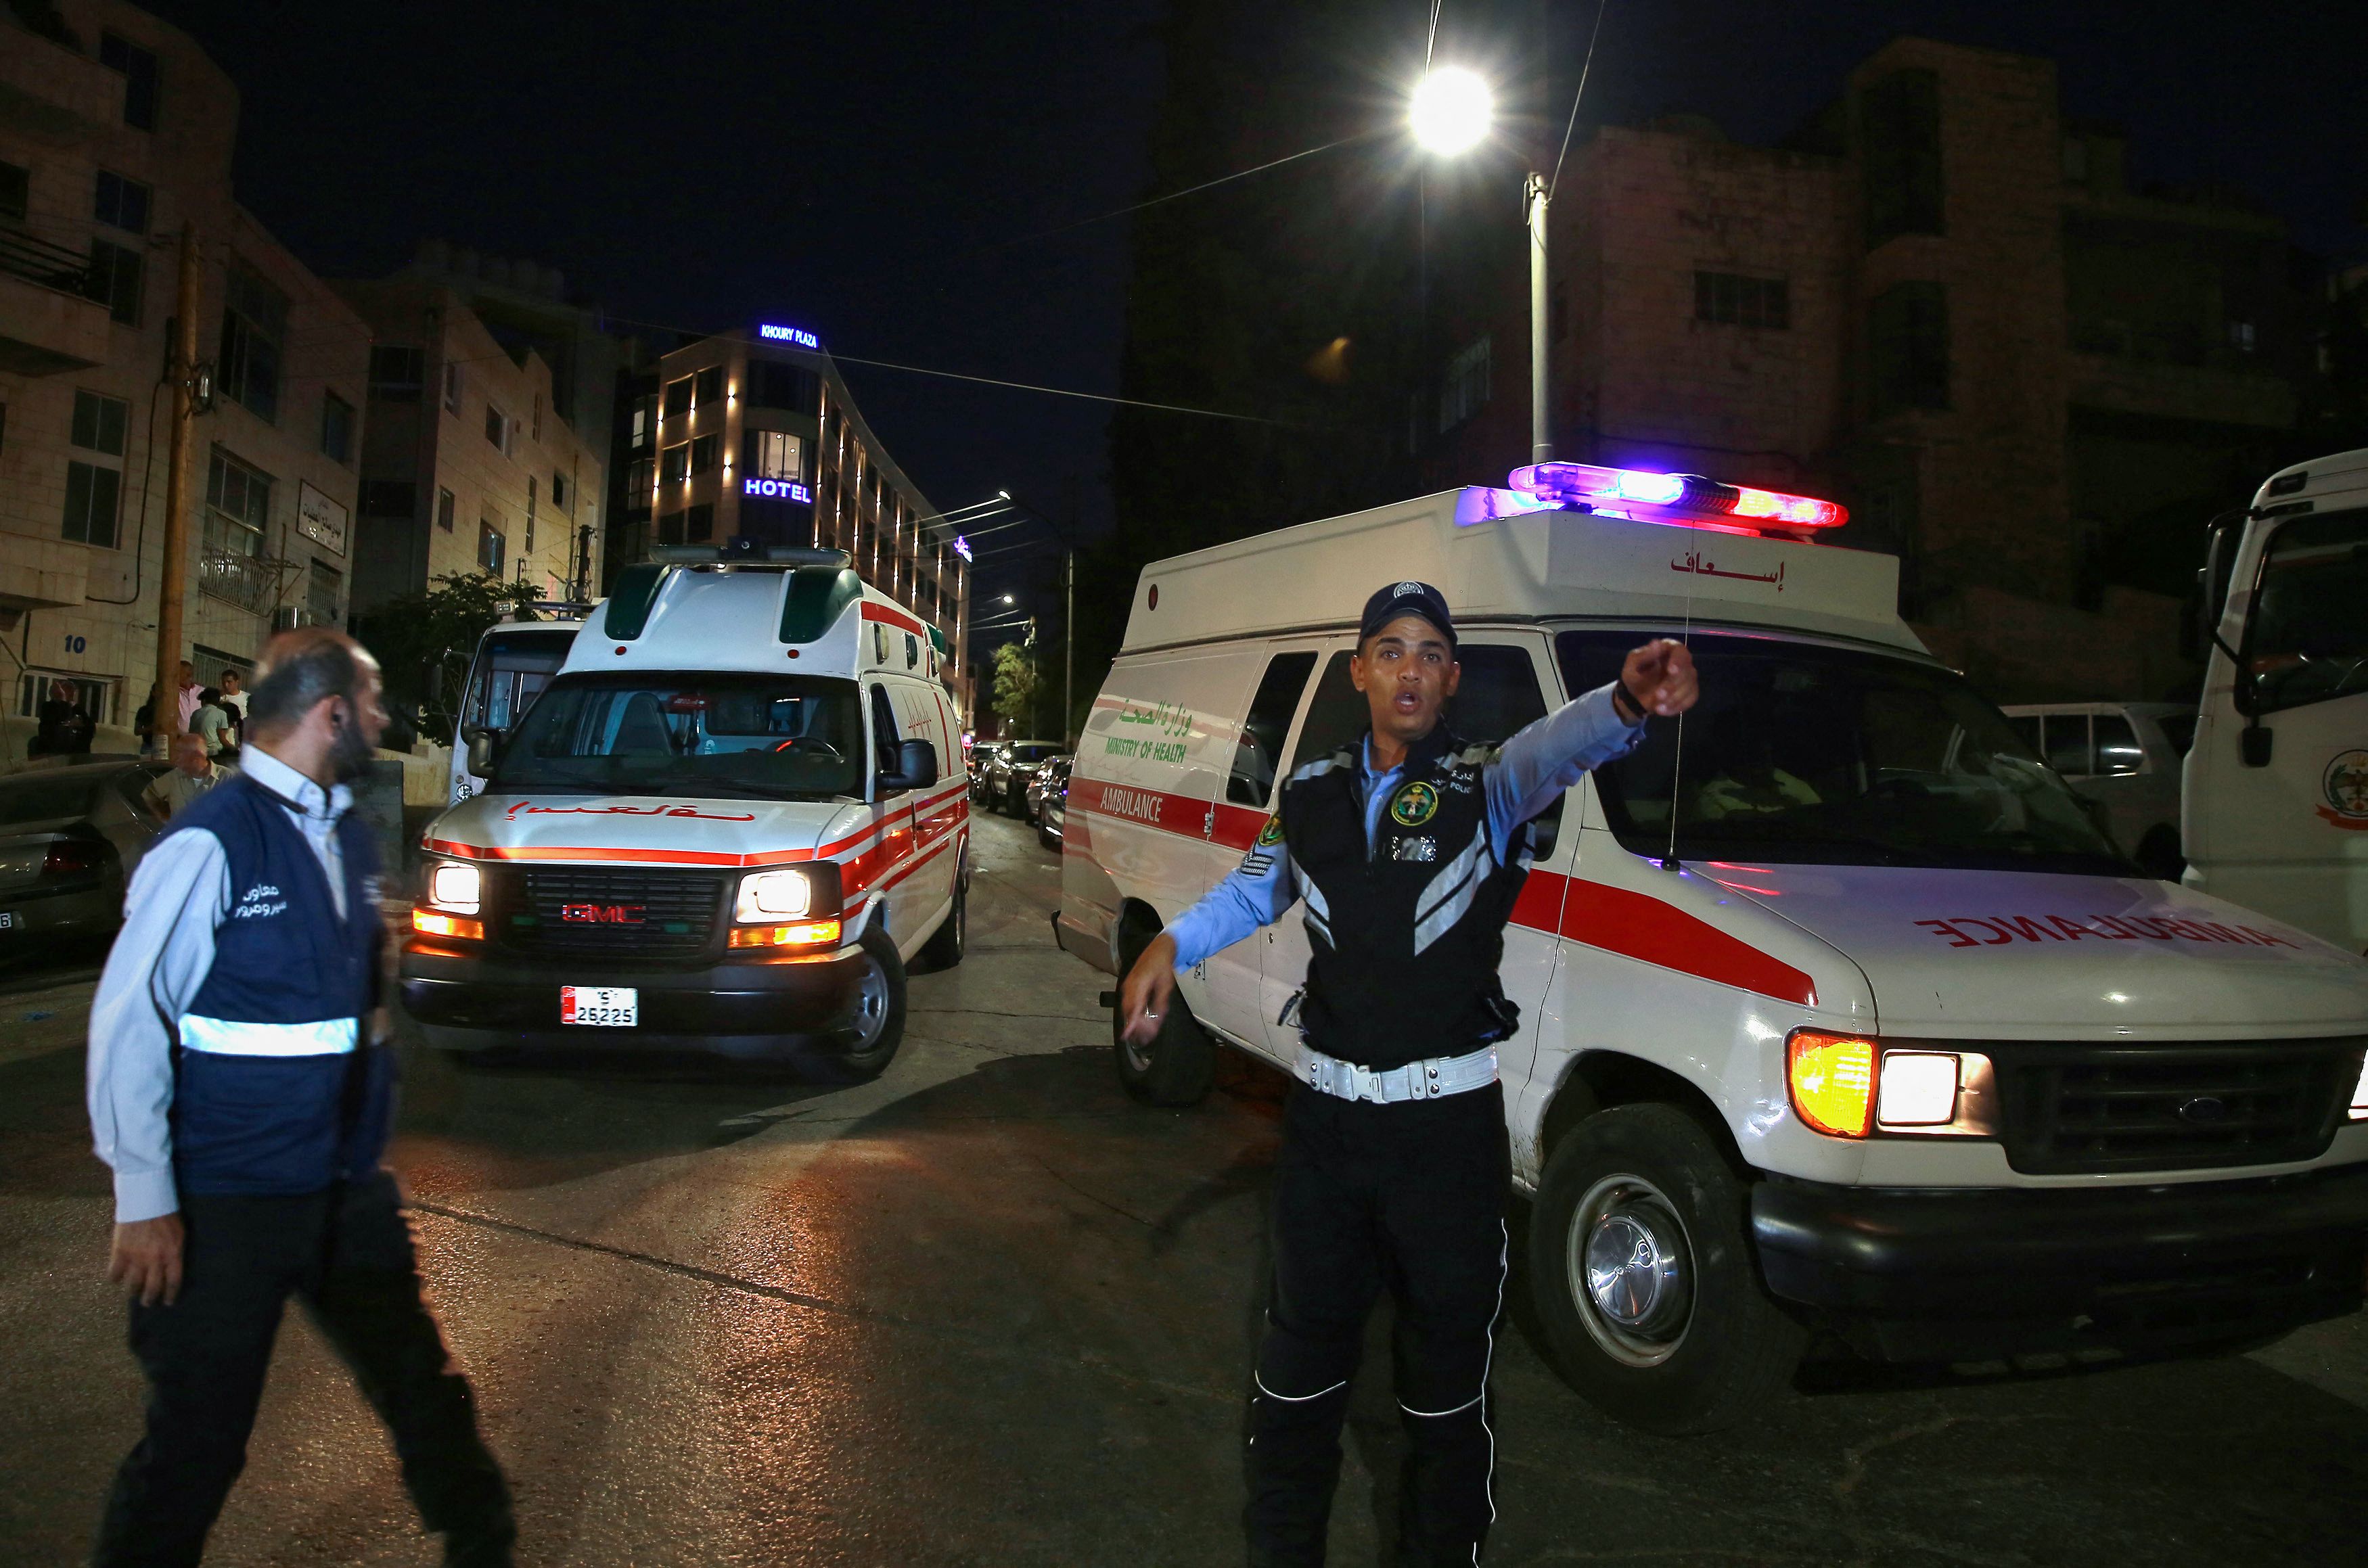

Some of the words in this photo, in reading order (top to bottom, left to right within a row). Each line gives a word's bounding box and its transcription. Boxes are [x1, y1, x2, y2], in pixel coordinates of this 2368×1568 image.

[760, 324, 794, 341] KHOURY
[795, 329, 817, 348] PLAZA
[745, 479, 812, 503] HOTEL
[1670, 551, 1785, 593] إسعاف
[65, 635, 86, 654] 10
[1118, 698, 1166, 726] الصحة
[1161, 701, 1193, 737] وزارة
[1104, 737, 1139, 758] MINISTRY
[1140, 741, 1154, 759] OF
[1153, 743, 1187, 764] HEALTH
[1100, 787, 1163, 823] AMBULANCE
[562, 904, 646, 923] GMC
[576, 1007, 633, 1023] 26225
